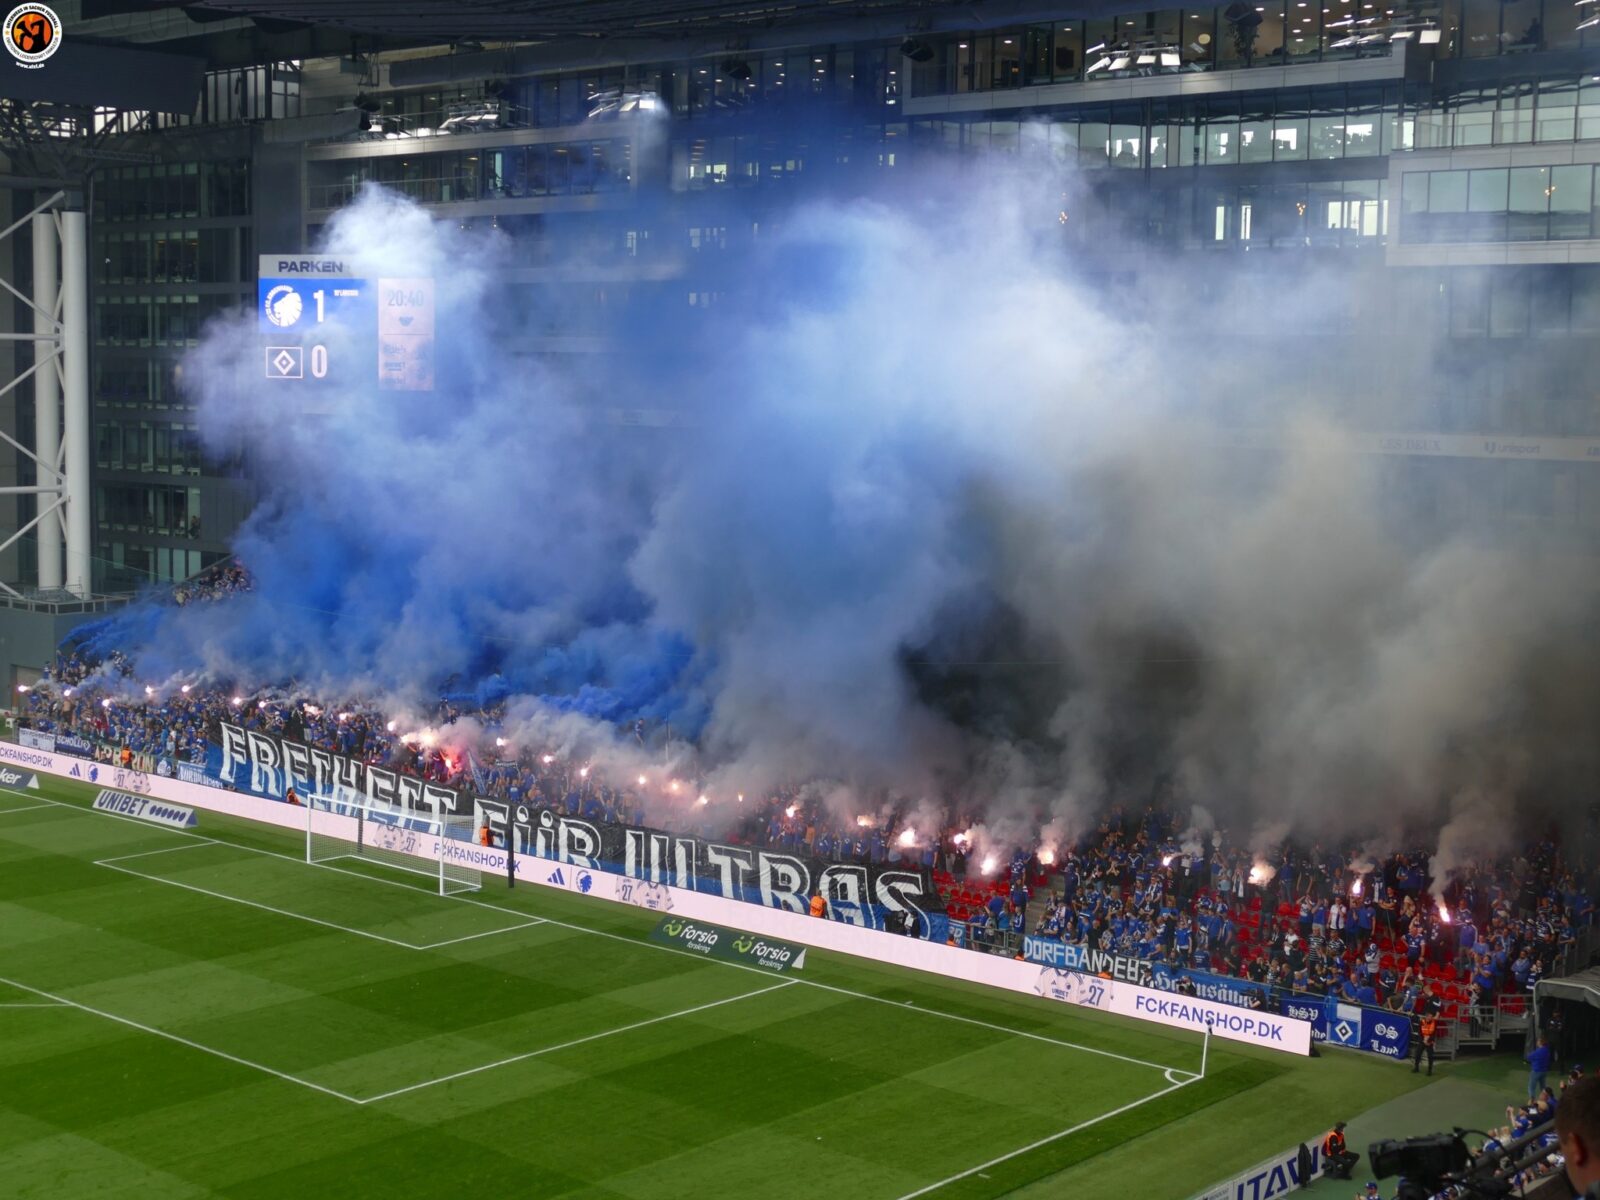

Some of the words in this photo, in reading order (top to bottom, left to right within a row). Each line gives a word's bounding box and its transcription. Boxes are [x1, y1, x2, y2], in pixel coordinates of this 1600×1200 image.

[278, 260, 343, 273] PARKEN
[313, 289, 325, 323] 1
[387, 288, 425, 307] 20:40
[311, 344, 328, 378] 0
[1405, 439, 1441, 452] DEUX
[220, 722, 458, 836] FREIHEIT
[98, 790, 150, 817] UNIBET
[622, 884, 633, 902] 27
[680, 925, 718, 945] forsia
[750, 941, 791, 962] forsia
[1088, 984, 1105, 1007] 27
[1136, 995, 1283, 1041] FCKFANSHOP.DK
